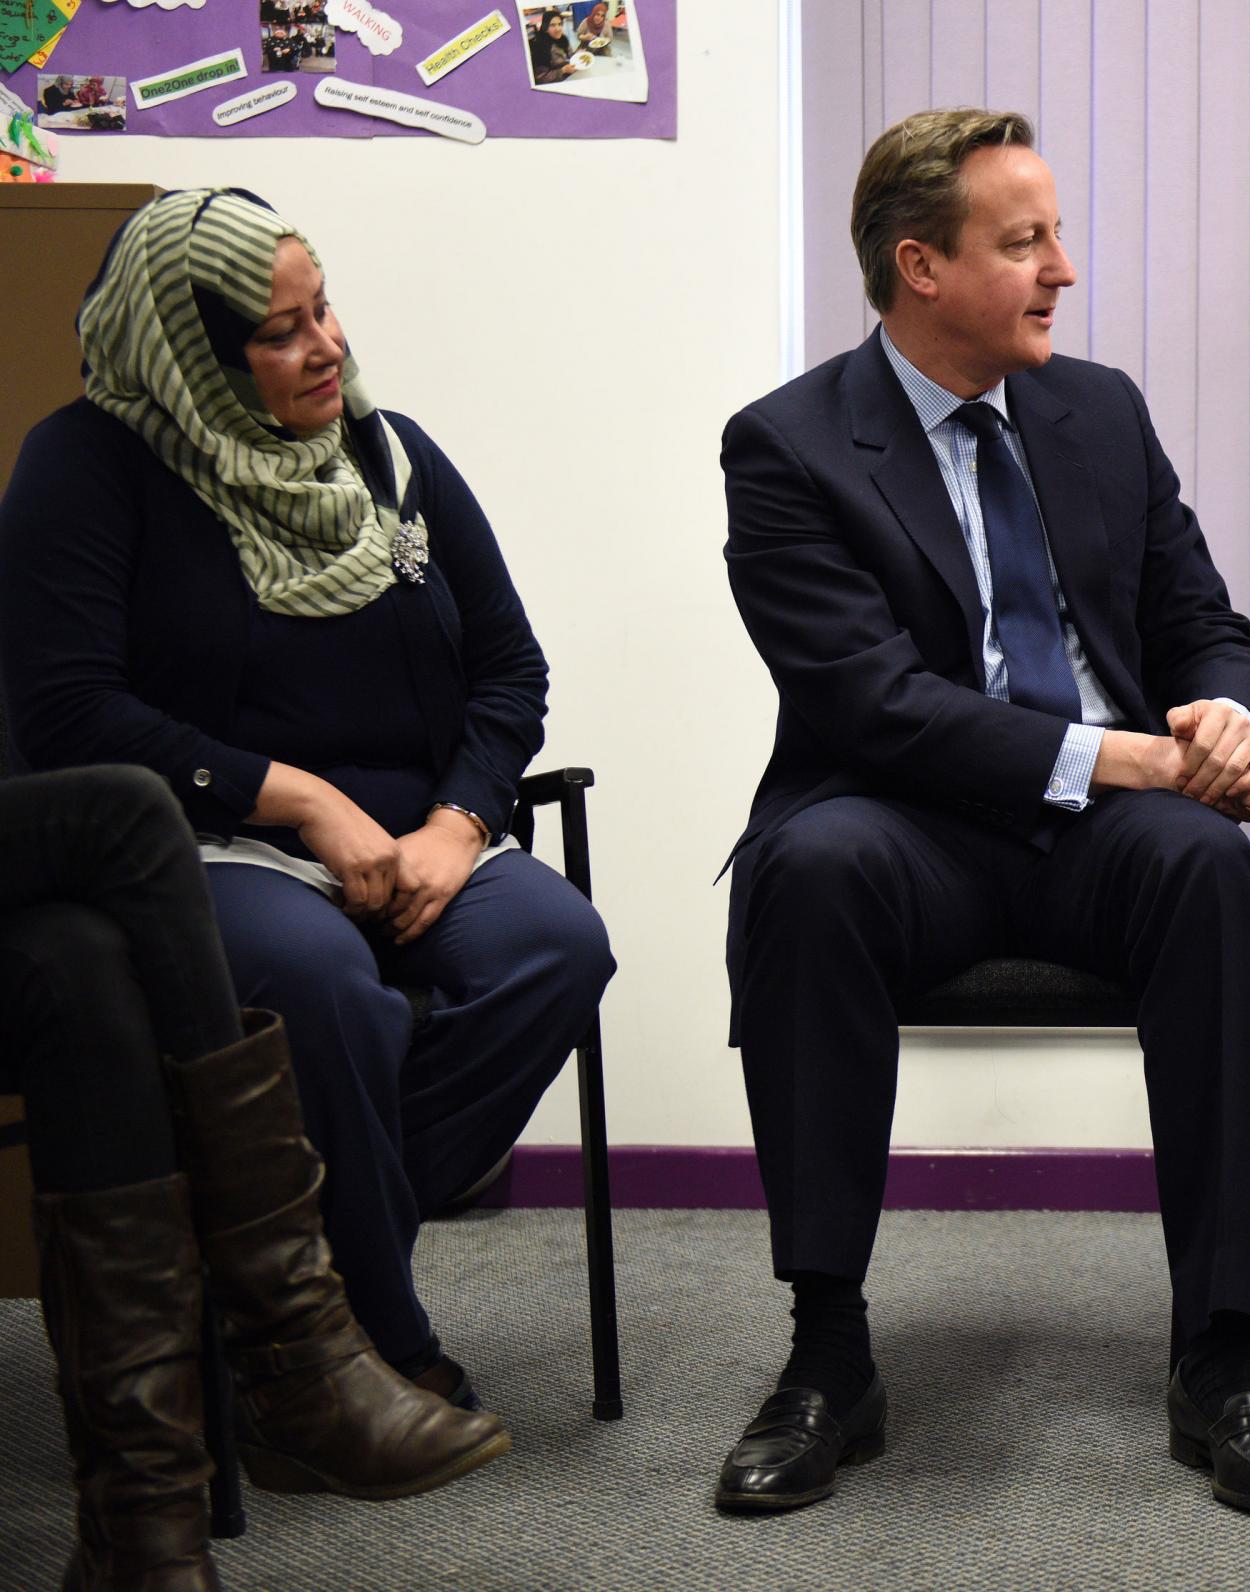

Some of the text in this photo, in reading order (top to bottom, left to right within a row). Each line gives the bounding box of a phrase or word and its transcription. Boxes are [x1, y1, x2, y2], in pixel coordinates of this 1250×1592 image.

[343, 0, 391, 41] WALKING
[140, 58, 240, 100] One2One drop in!
[426, 47, 462, 75] Health
[217, 86, 289, 120] Improving behaviour
[325, 86, 473, 128] Raising self esteem and self confidence
